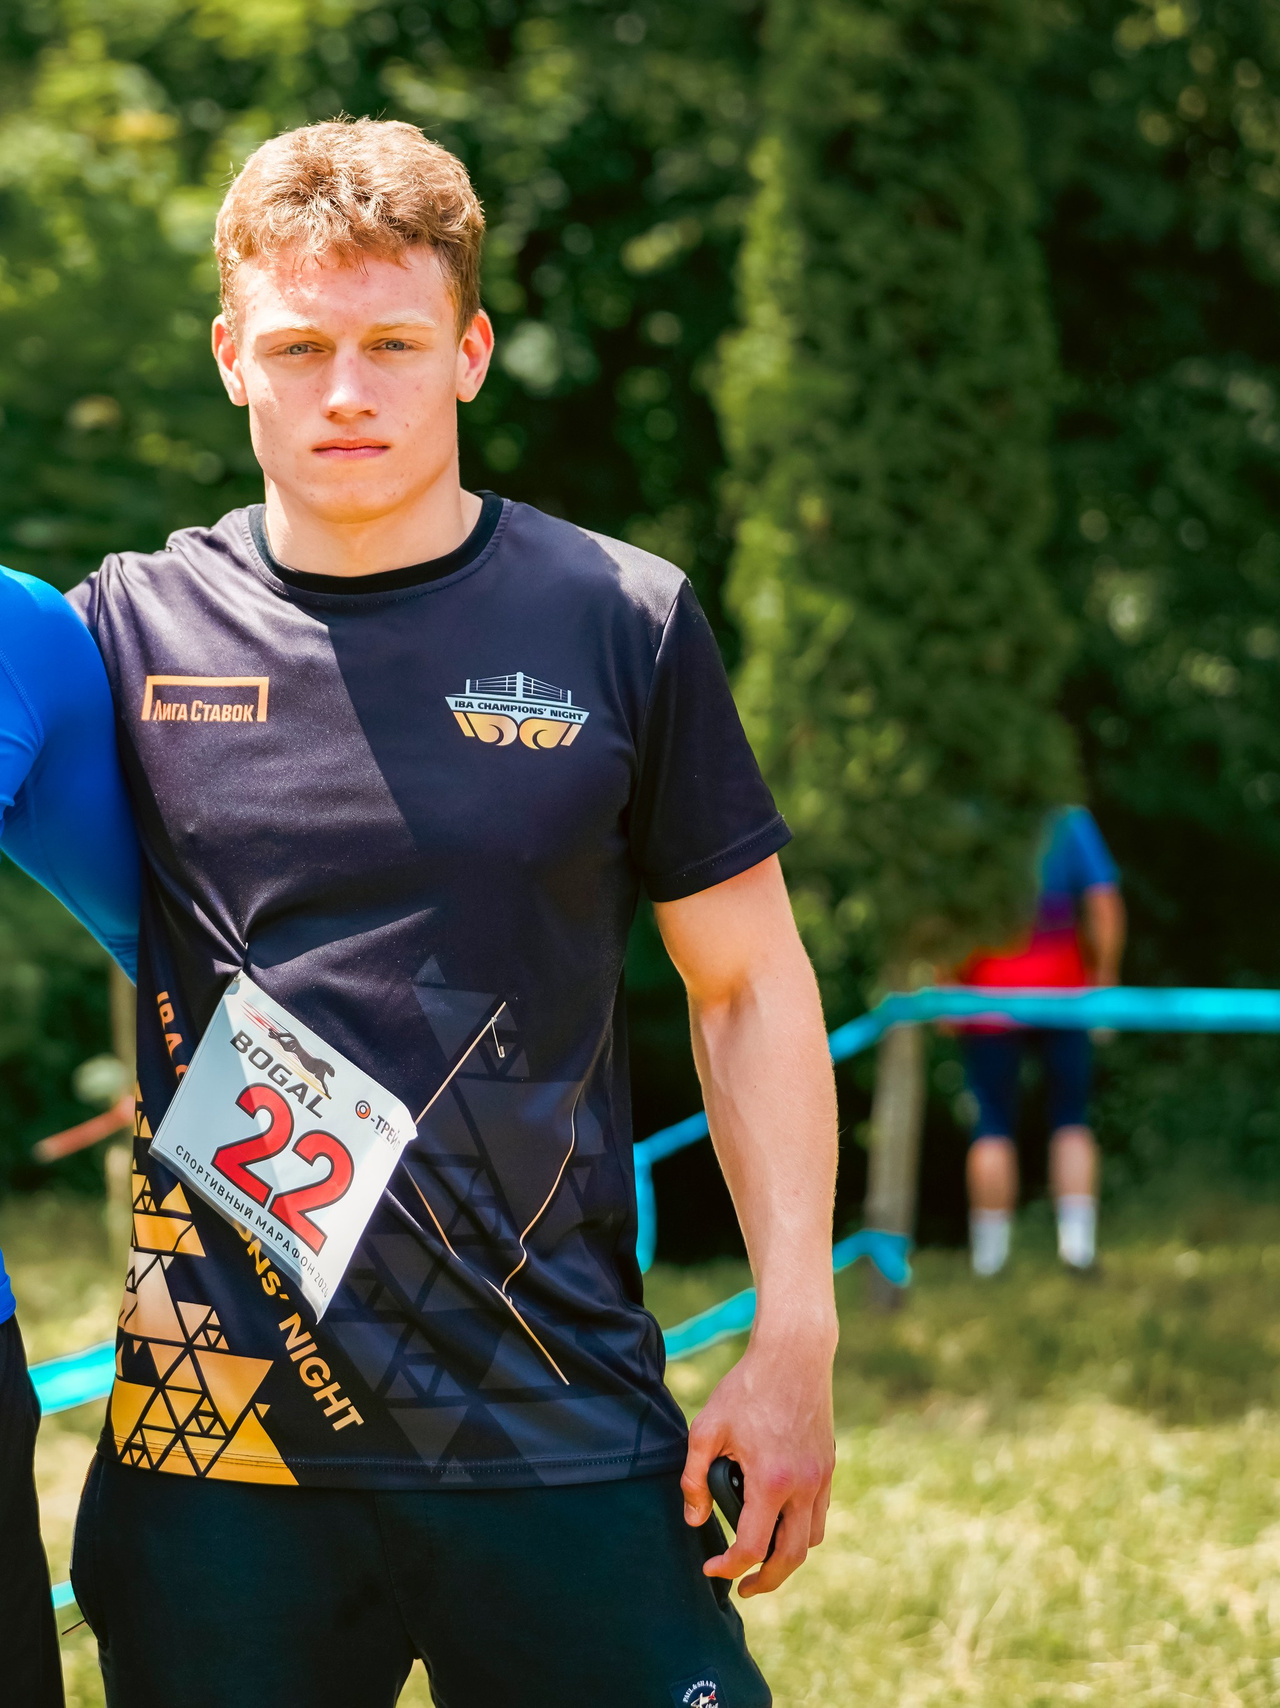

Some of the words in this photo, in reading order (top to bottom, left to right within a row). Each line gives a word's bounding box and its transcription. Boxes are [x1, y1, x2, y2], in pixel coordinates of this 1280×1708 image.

[454, 700, 474, 709] IBA
[550, 709, 583, 721] NIGHT
[230, 1030, 323, 1118] BOGAL
[176, 1145, 254, 1219] СПОРТИВНЫЙ
[255, 1216, 315, 1276] МАРАФОН
[210, 1082, 355, 1257] 22
[278, 1311, 365, 1431] NIGHT
